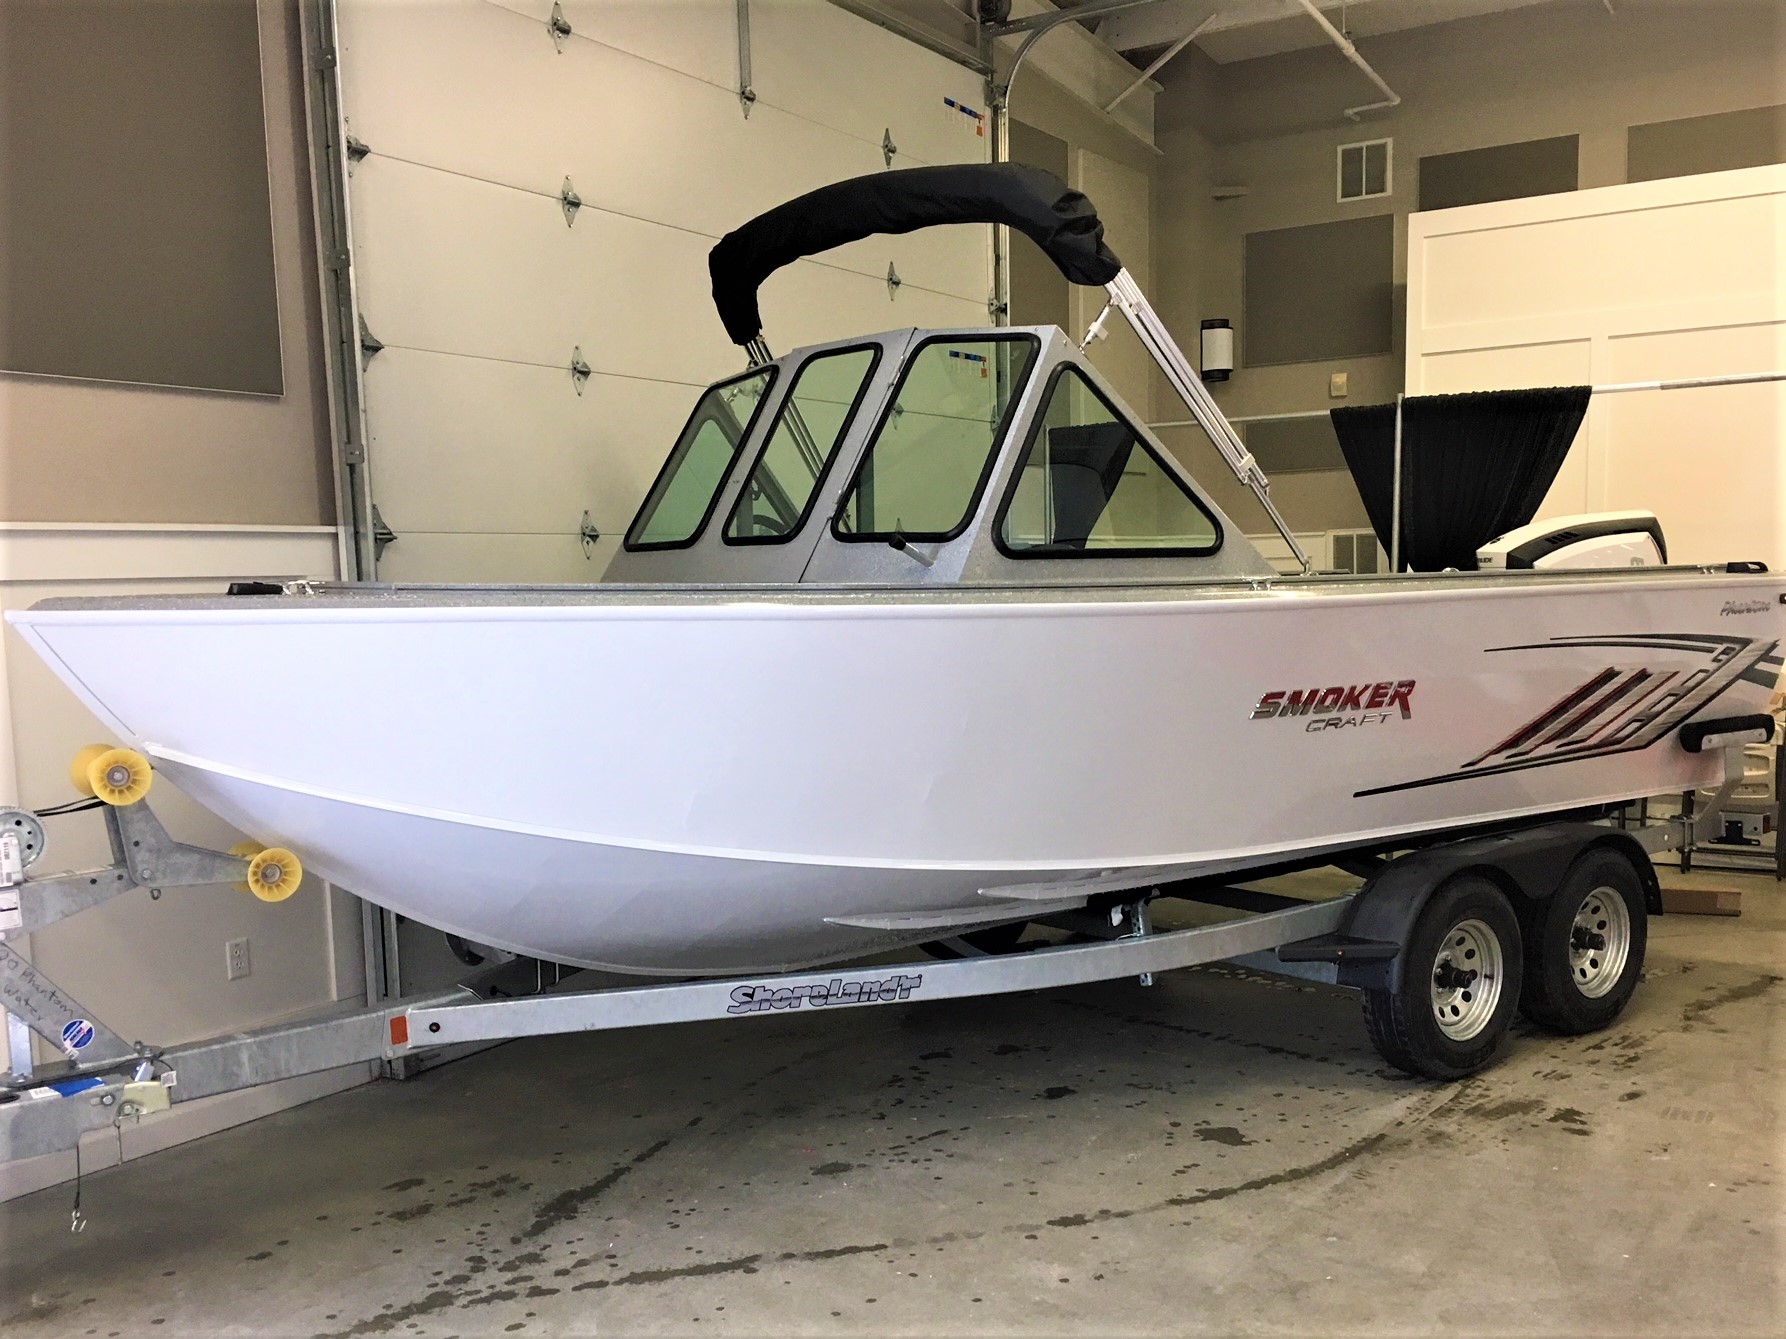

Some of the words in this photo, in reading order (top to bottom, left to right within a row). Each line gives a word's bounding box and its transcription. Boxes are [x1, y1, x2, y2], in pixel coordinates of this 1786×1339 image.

[1248, 679, 1416, 720] SMOKER
[1305, 711, 1393, 733] CRAFT
[4, 983, 44, 1021] Water
[20, 967, 74, 1018] Phantom
